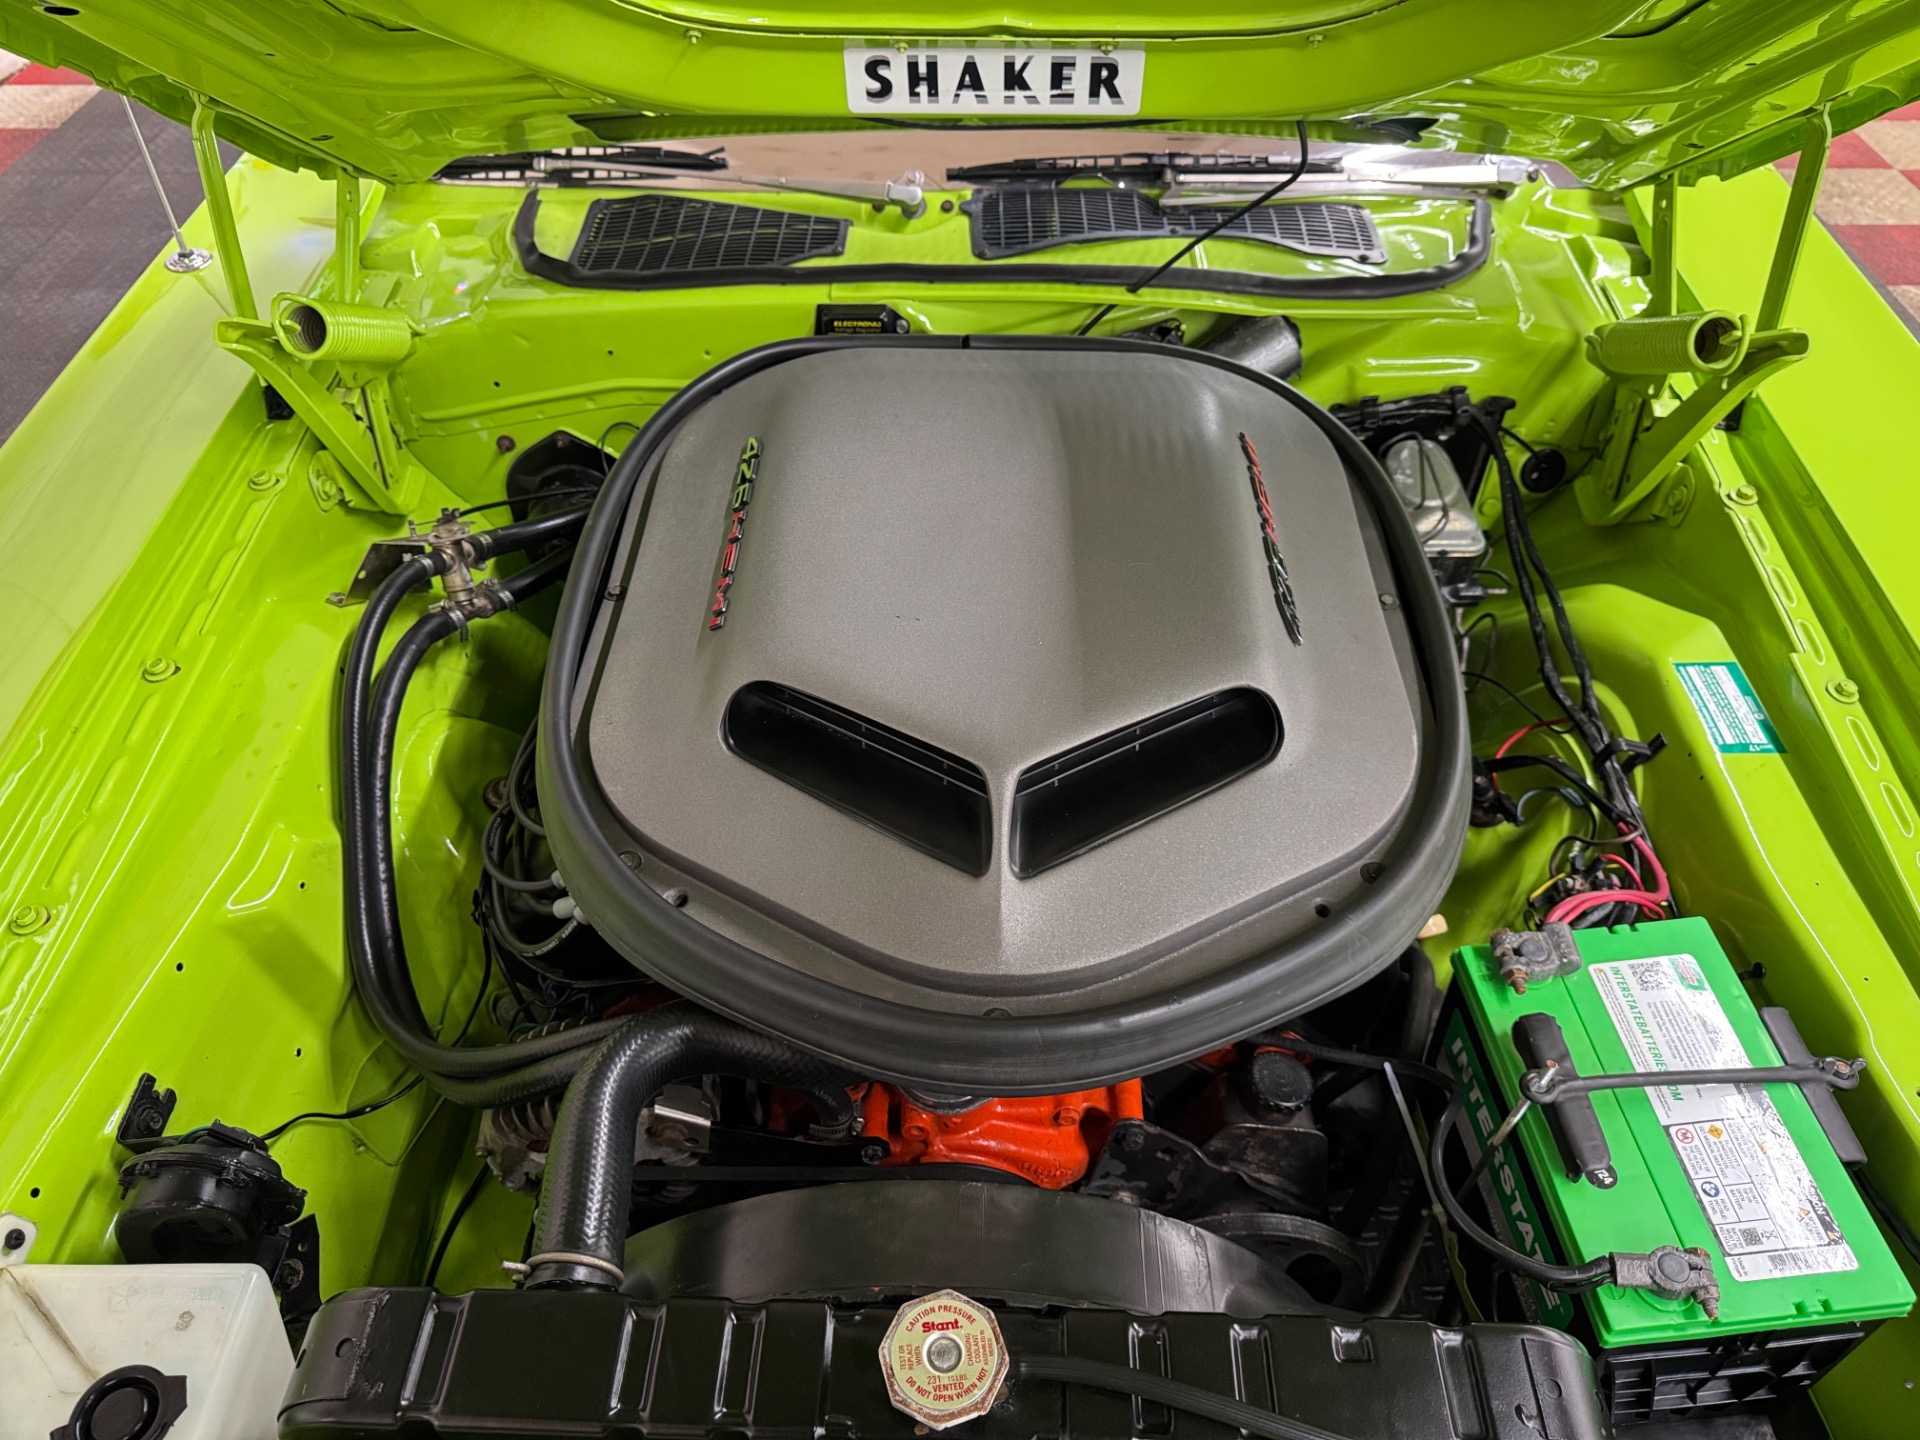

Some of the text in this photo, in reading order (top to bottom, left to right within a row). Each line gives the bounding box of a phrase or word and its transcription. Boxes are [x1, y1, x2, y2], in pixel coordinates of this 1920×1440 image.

[864, 55, 1125, 105] SHAKER
[708, 436, 762, 631] 426 HEMI
[905, 1304, 977, 1333] CAUTION PRESSURE
[914, 1345, 922, 1366] WHEN
[964, 1332, 974, 1367] CHANGING
[972, 1334, 981, 1364] COOLANT
[905, 1366, 989, 1402] DO NOT OPEN WHEN HOT
[926, 1375, 941, 1385] 231
[932, 1382, 965, 1393] VENTED
